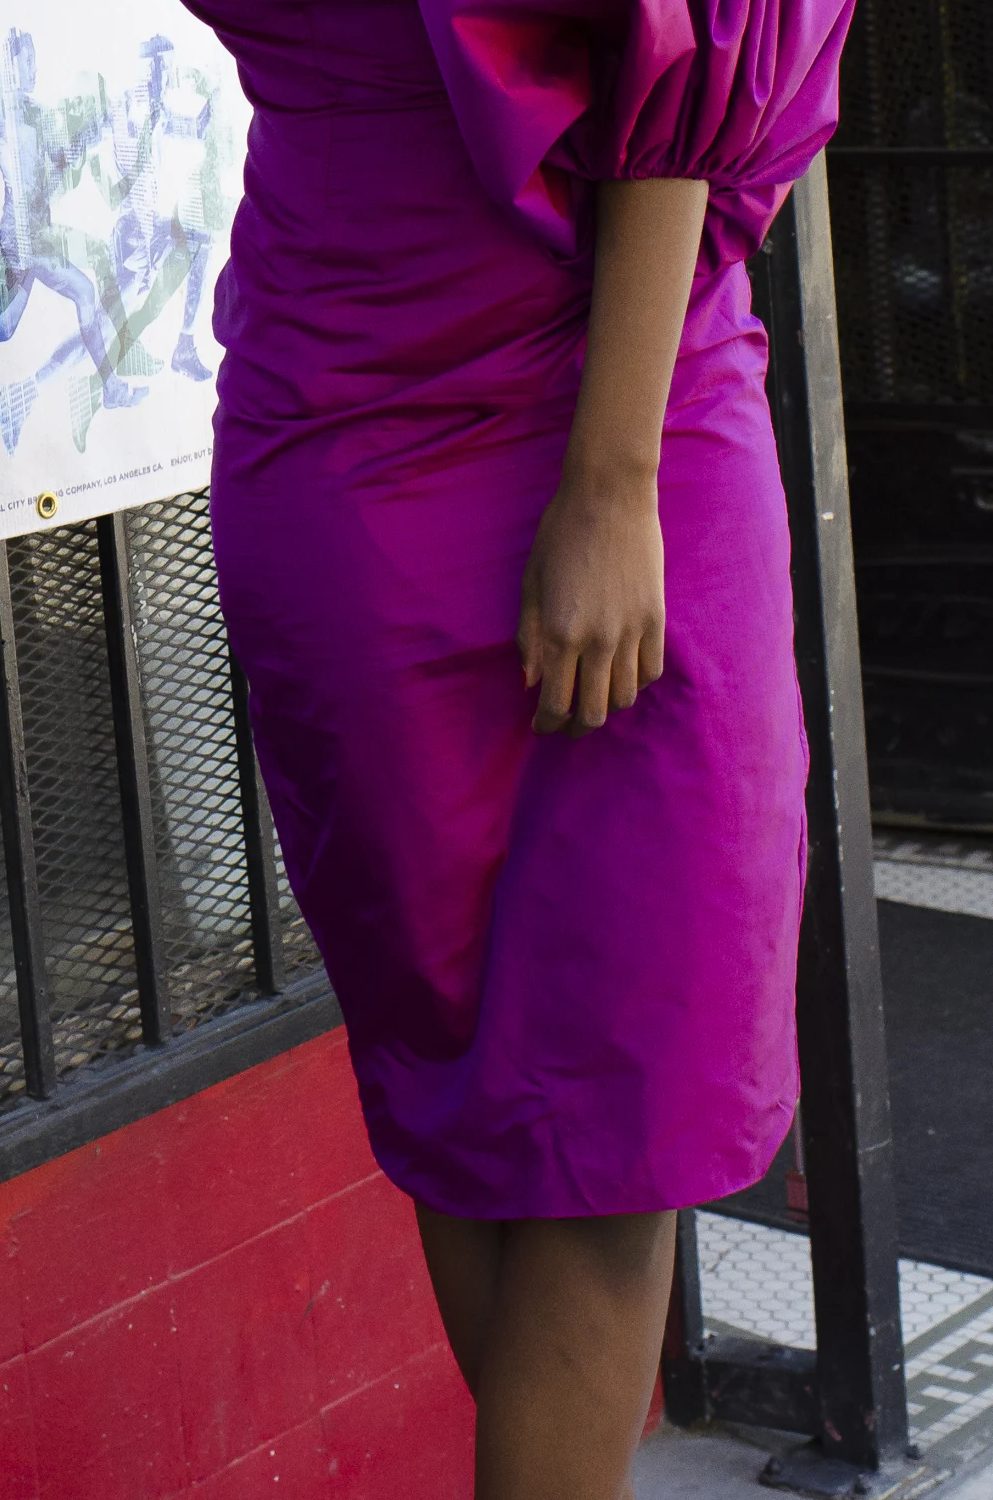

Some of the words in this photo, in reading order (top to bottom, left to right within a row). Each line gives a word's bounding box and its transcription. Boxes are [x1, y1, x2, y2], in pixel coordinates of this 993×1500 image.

[7, 499, 25, 510] CITY
[104, 475, 117, 486] LOS
[119, 465, 151, 481] ANGELES
